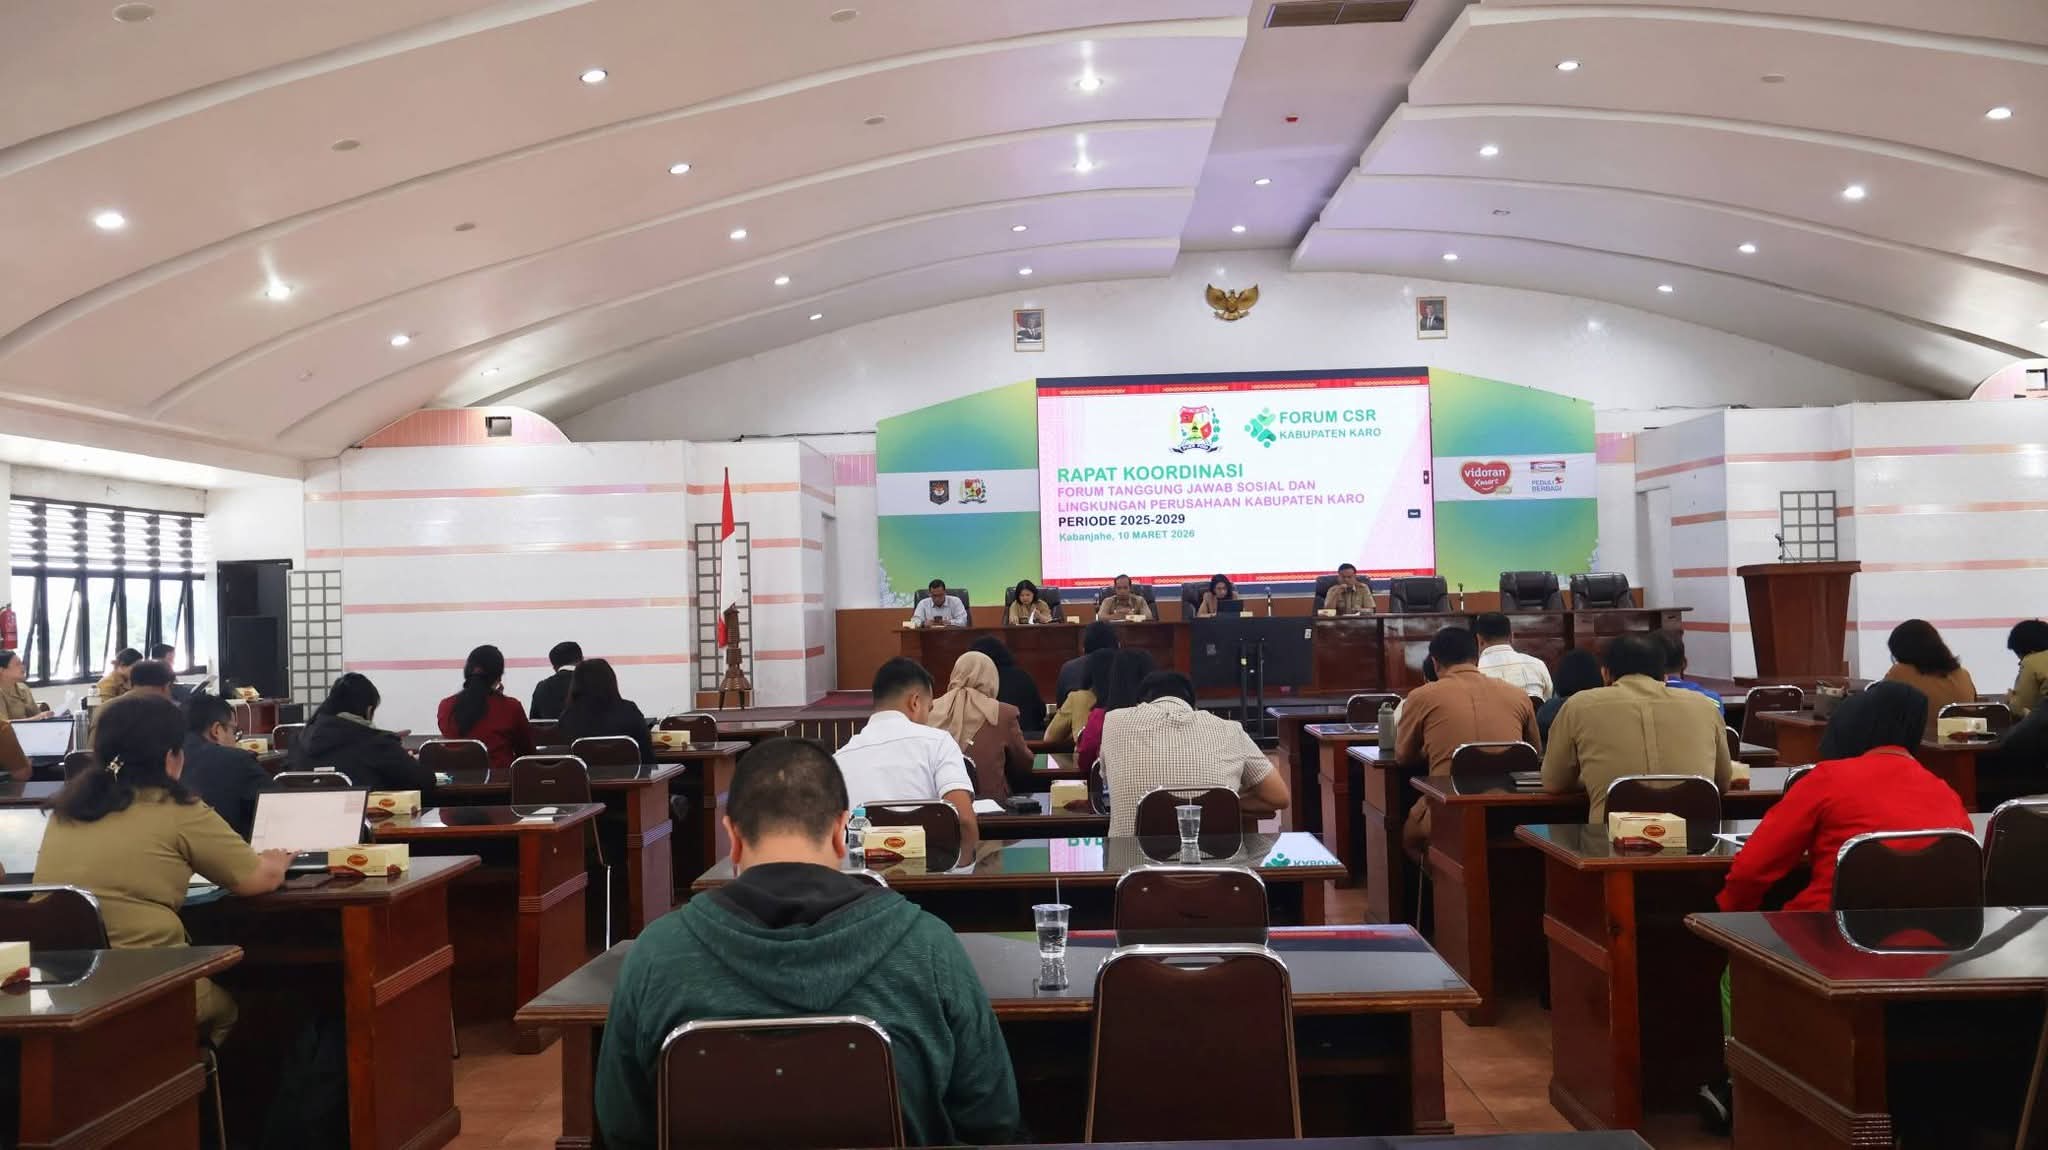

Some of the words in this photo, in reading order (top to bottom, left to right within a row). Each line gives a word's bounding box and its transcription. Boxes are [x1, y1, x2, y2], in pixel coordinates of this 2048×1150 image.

[1279, 411, 1338, 424] FORUM
[1342, 409, 1377, 422] CSR
[1279, 430, 1346, 439] KABUPATEN
[1349, 427, 1382, 438] KARO
[1057, 467, 1117, 482] RAPAT
[1123, 463, 1244, 480] KOORDINASI
[1464, 467, 1506, 478] vidoran
[1057, 487, 1104, 498] FORUM
[1108, 483, 1183, 497] TANGGUNG
[1186, 482, 1233, 495] JAWAB
[1237, 480, 1285, 492] SOSIAL
[1288, 479, 1316, 491] DAN
[1058, 501, 1146, 513] LINGKUNGAN
[1151, 498, 1241, 509] PERUSAHAAN
[1245, 495, 1323, 507] KABUPATEN
[1327, 493, 1365, 505] KARO
[1058, 515, 1117, 527] PERIODE
[1120, 513, 1186, 526] 2025-2029
[1118, 531, 1129, 540] 10
[1132, 530, 1168, 540] MARET
